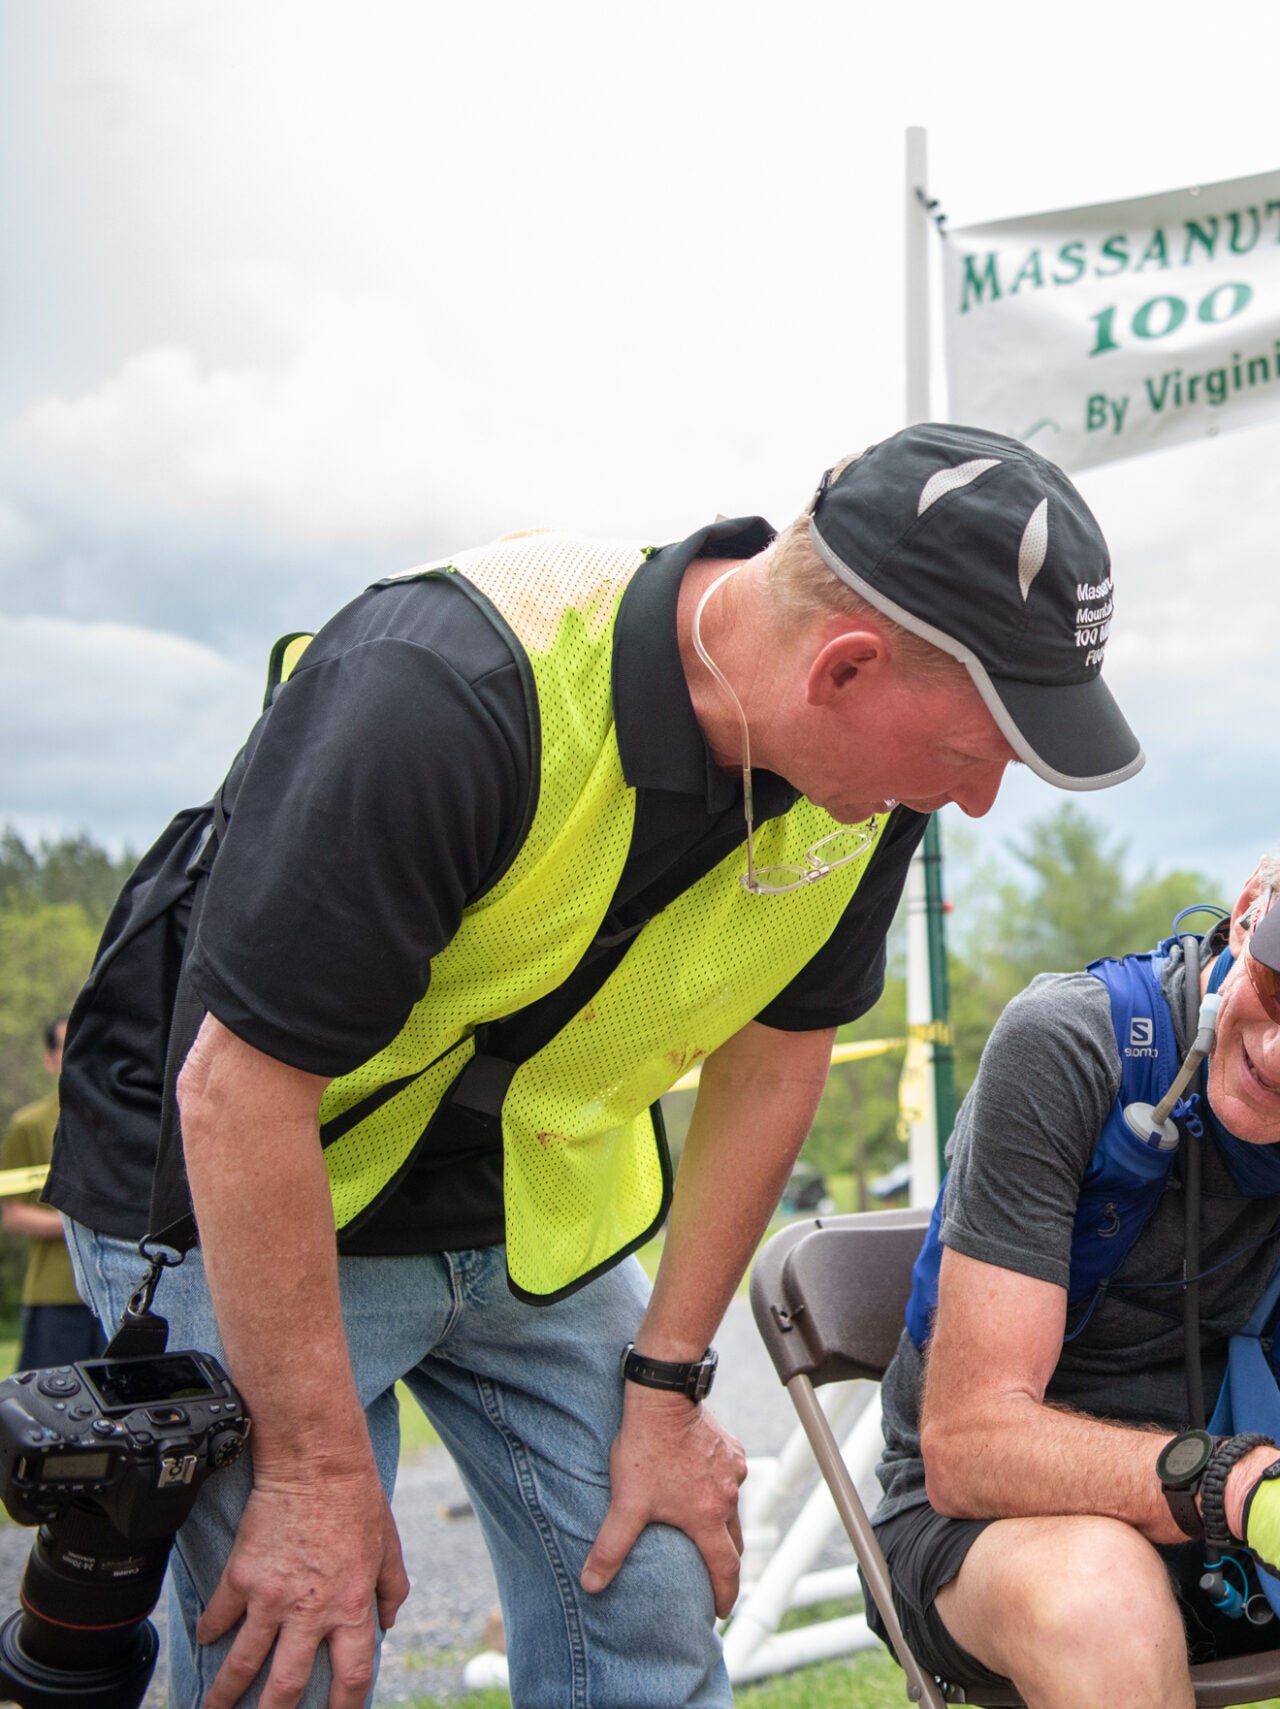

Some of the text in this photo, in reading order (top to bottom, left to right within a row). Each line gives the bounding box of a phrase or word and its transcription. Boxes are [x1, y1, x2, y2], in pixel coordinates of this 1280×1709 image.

[1088, 281, 1253, 358] 100
[1085, 394, 1130, 434] By
[1074, 627, 1098, 647] 100
